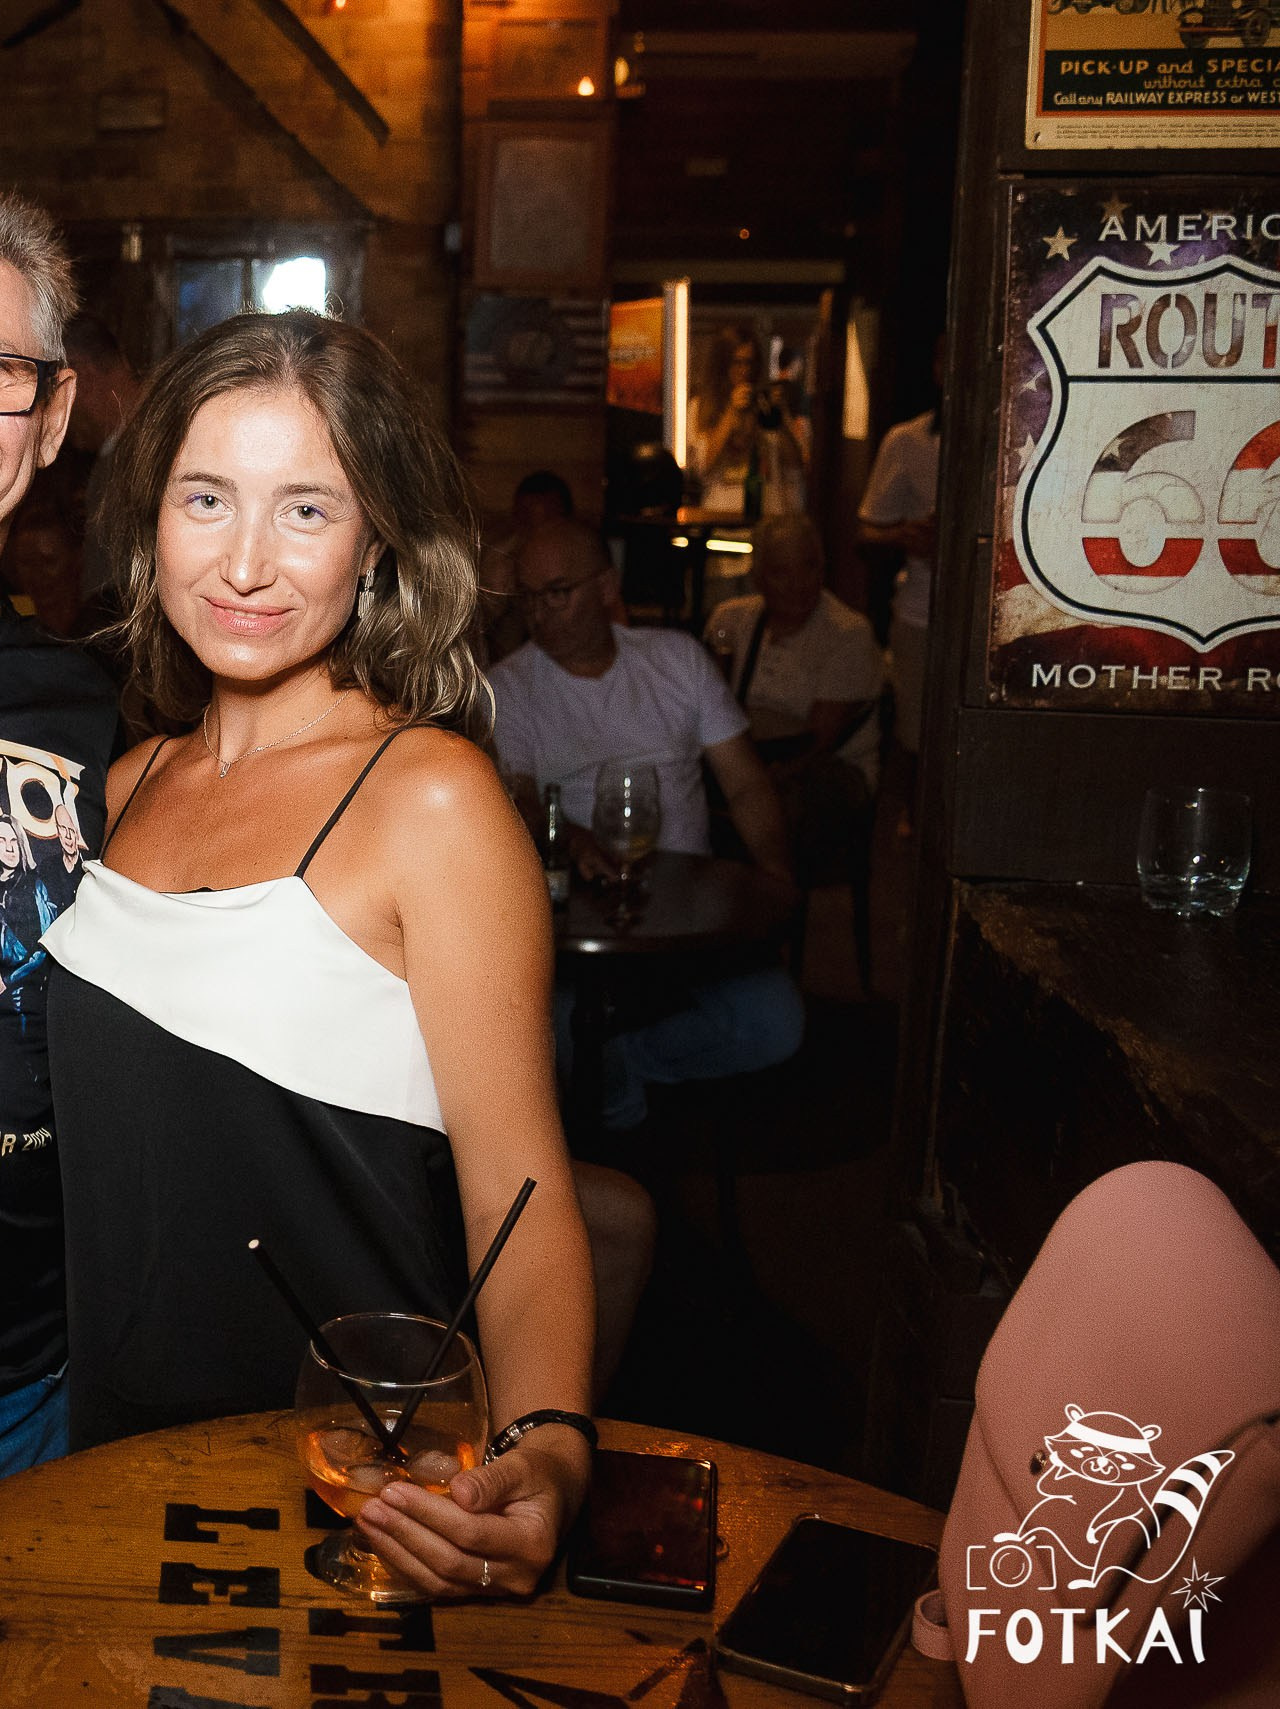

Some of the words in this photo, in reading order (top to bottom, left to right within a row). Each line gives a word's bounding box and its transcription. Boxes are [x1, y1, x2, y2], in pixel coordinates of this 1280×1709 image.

[1157, 60, 1193, 74] and
[1144, 75, 1205, 89] without
[1216, 75, 1263, 88] extra
[1053, 91, 1076, 105] Call
[1078, 95, 1103, 106] any
[1105, 91, 1164, 104] RAILWAY
[1168, 91, 1227, 104] EXPRESS
[1230, 95, 1245, 104] or
[1098, 214, 1280, 241] AMERIC
[1097, 293, 1280, 370] ROUT
[1030, 664, 1222, 690] MOTHER
[1248, 667, 1280, 691] R
